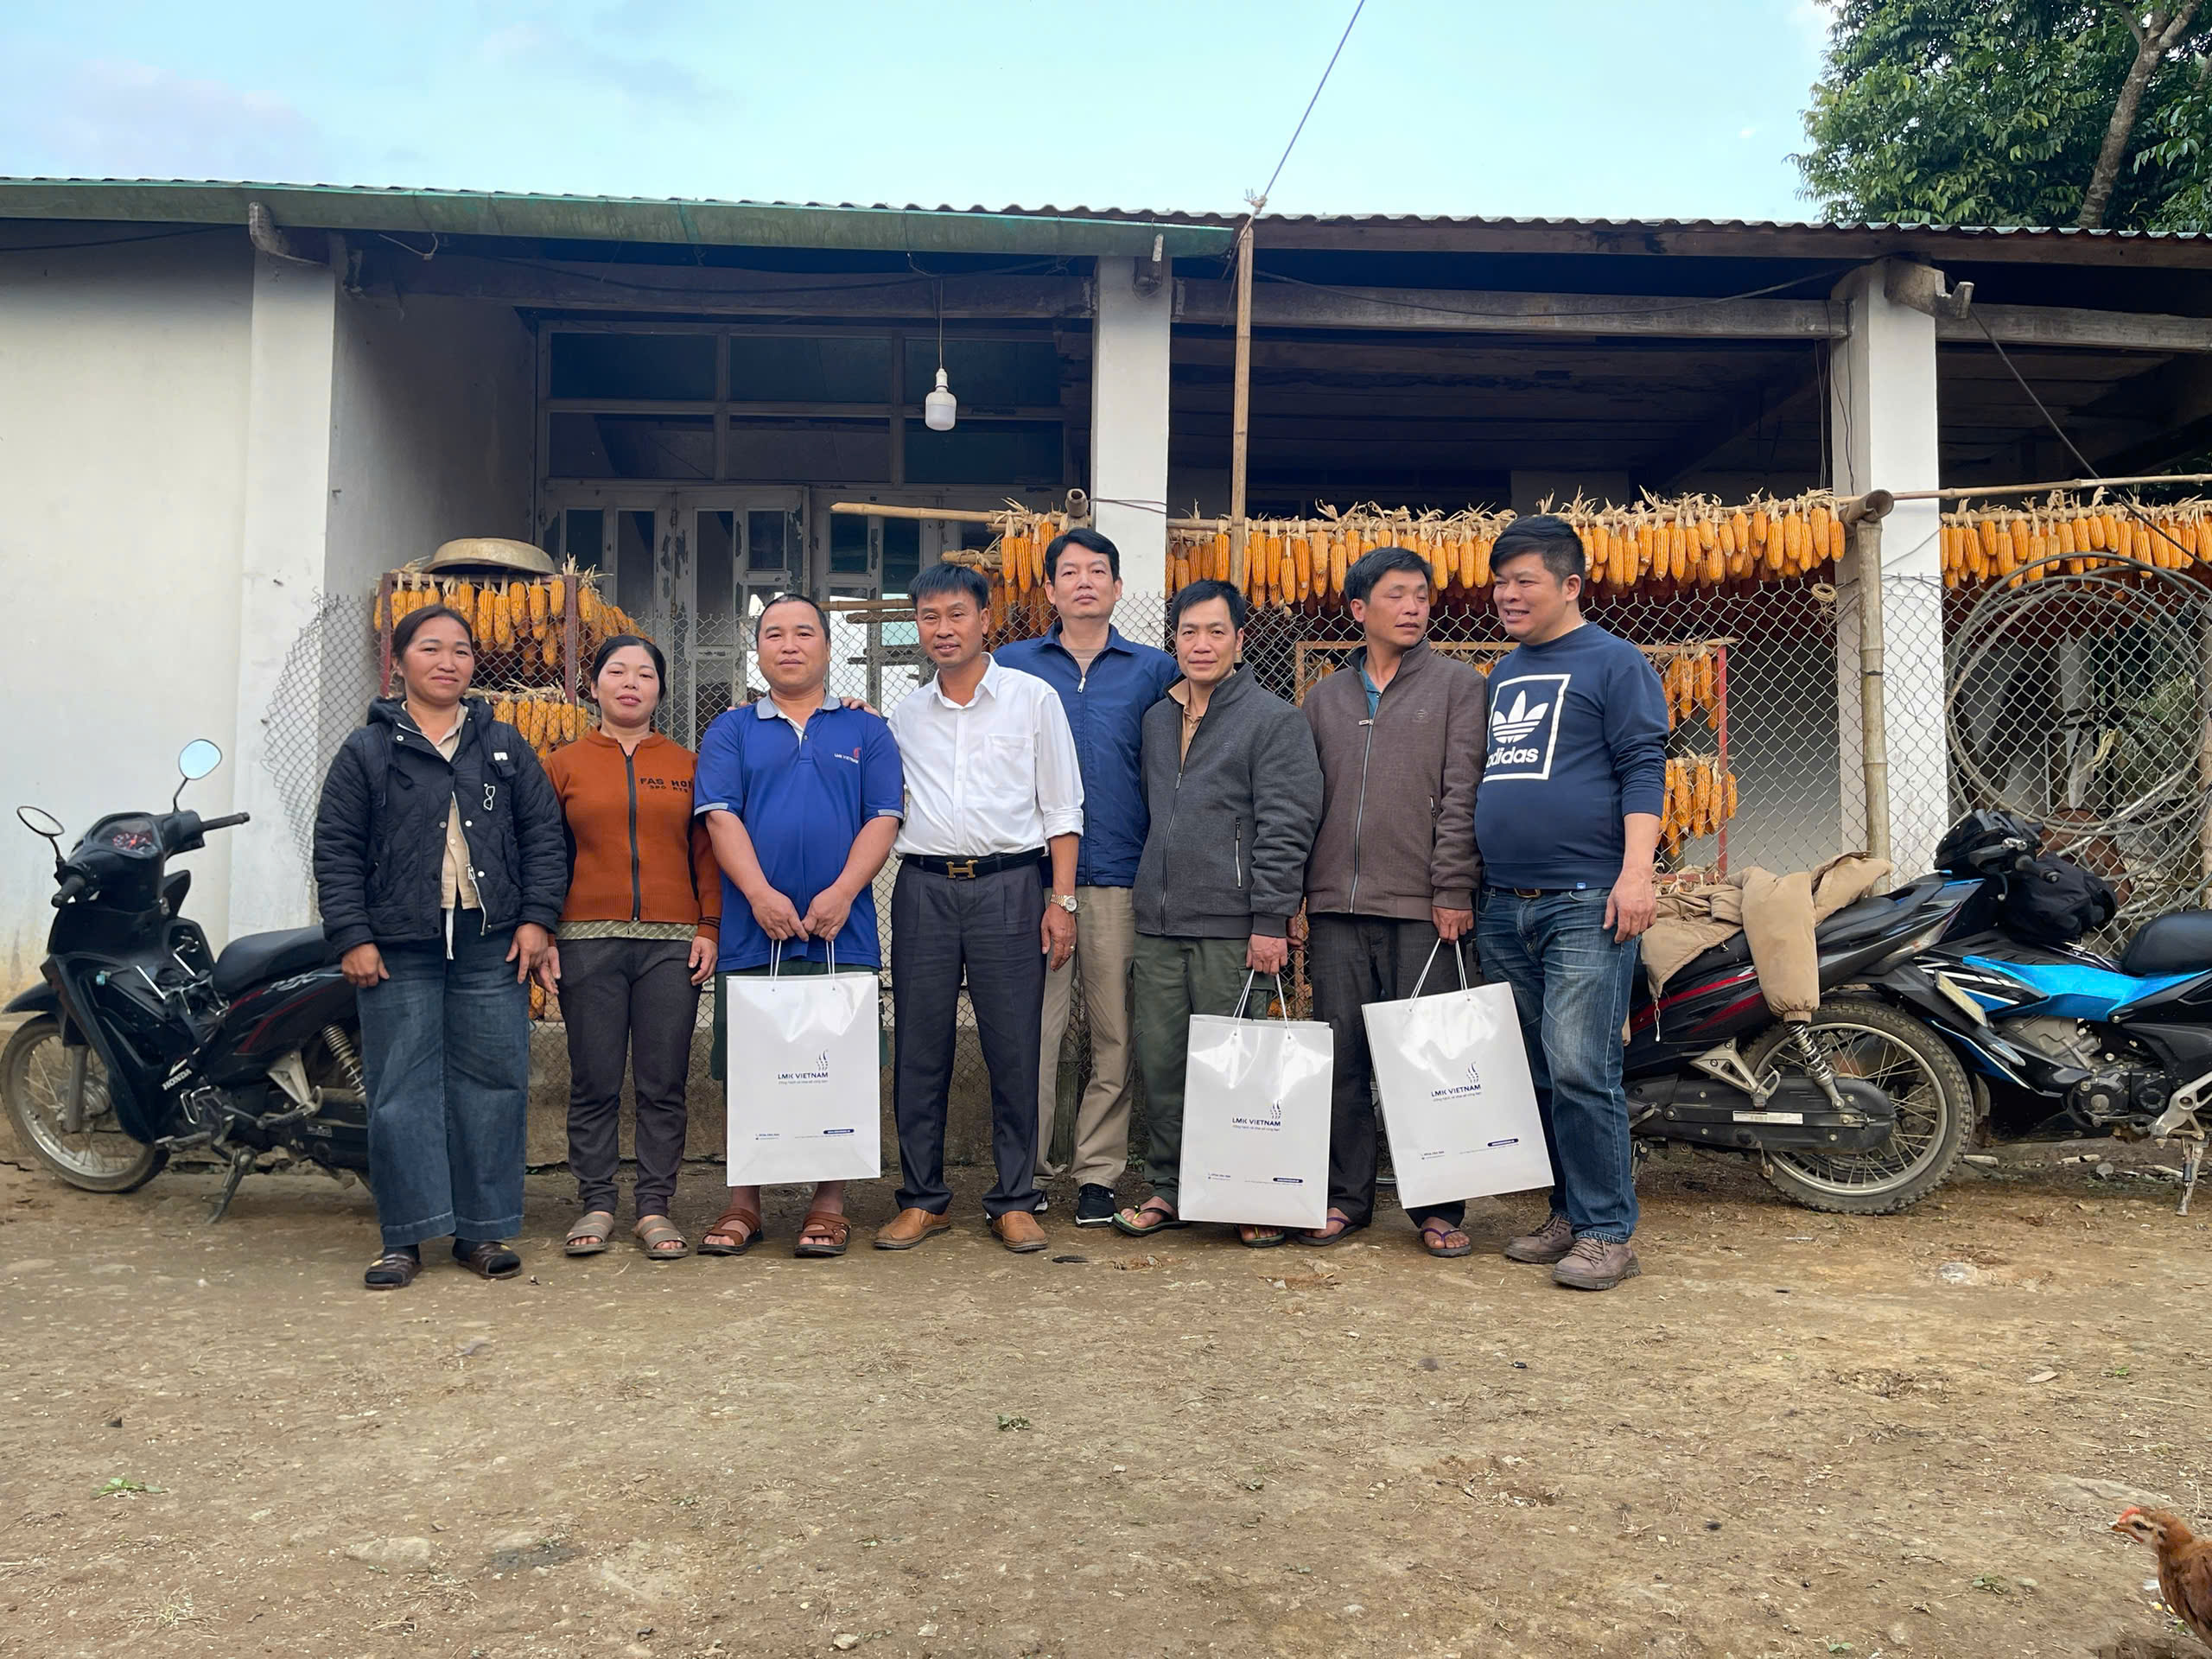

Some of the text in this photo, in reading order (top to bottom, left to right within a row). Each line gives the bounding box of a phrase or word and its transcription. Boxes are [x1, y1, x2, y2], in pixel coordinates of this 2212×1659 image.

[1485, 746, 1539, 768] adidas
[162, 1068, 193, 1090] HONDA
[1431, 1089, 1447, 1097] LMK
[1447, 1084, 1482, 1095] VIETNAM
